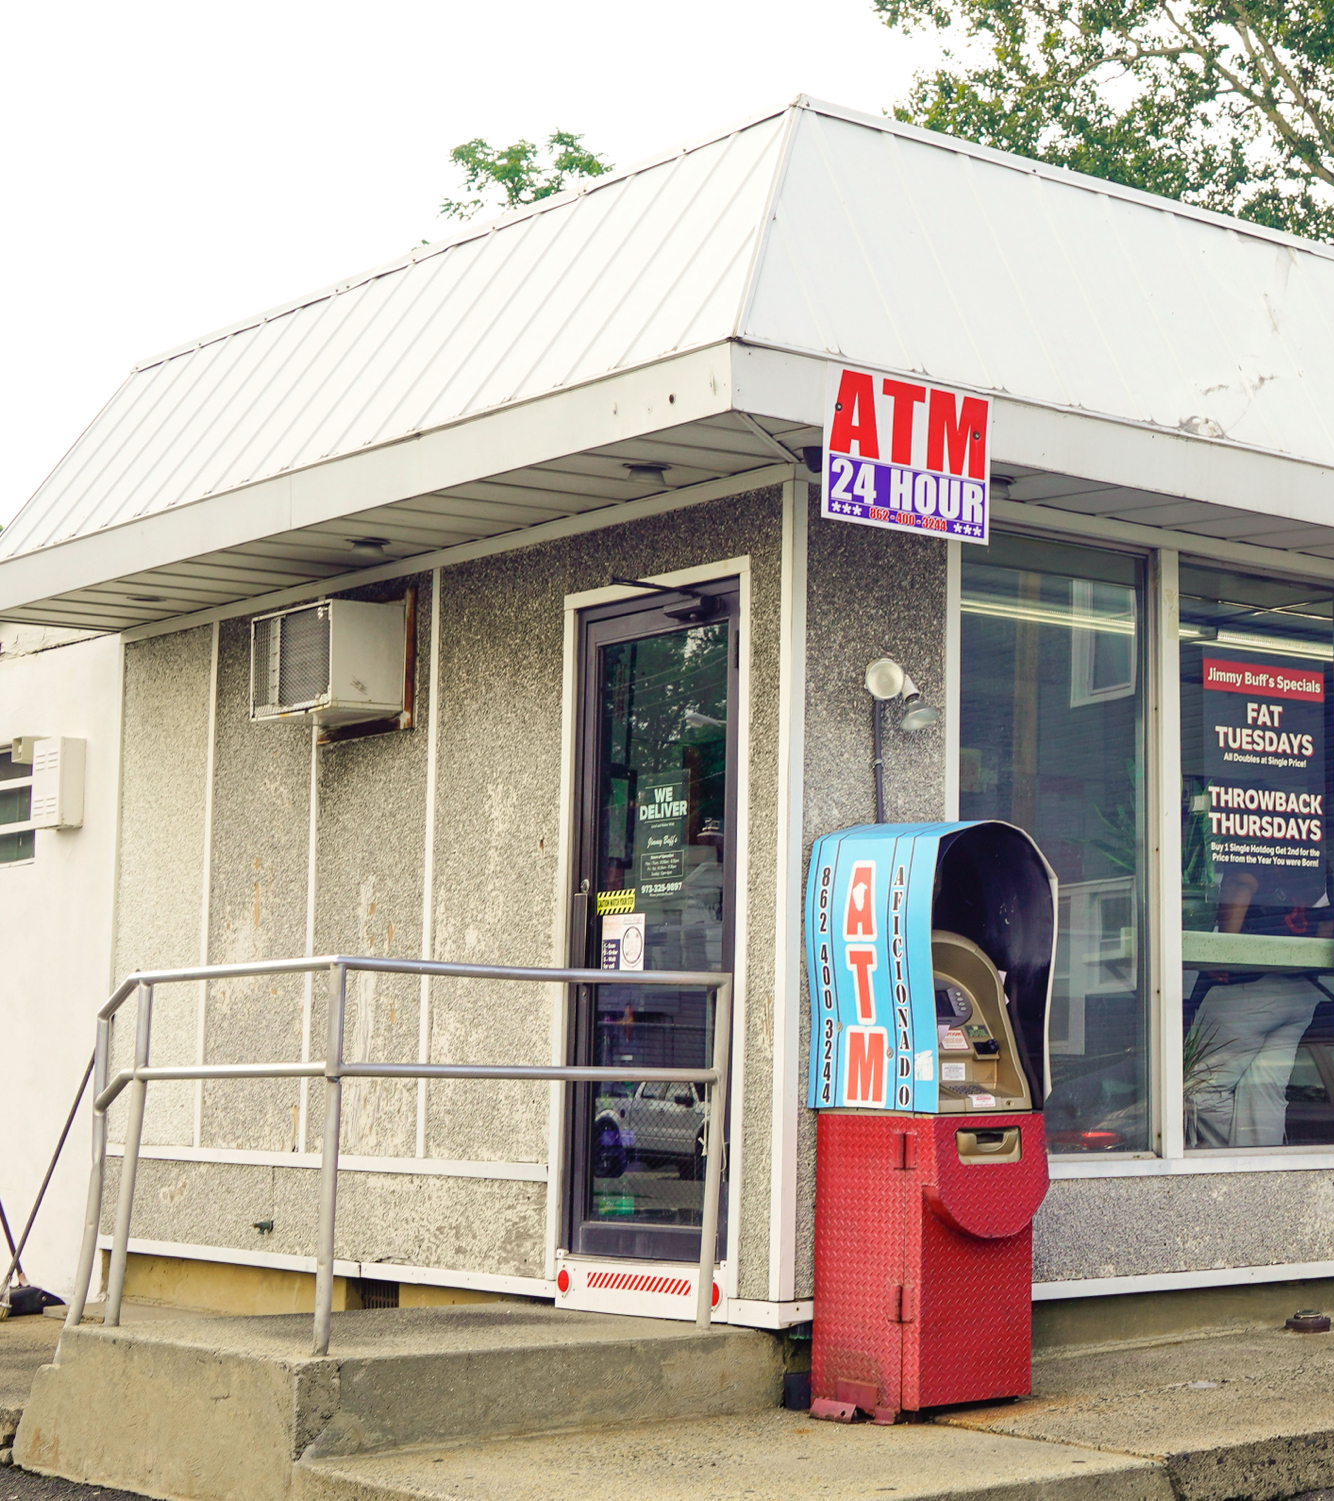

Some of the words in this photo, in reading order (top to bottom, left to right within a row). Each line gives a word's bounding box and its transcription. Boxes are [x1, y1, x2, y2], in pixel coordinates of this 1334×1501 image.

[829, 369, 989, 481] ATM
[830, 459, 877, 505] 24
[890, 467, 984, 523] HOUR
[1207, 667, 1242, 686] Jimmy
[1244, 672, 1275, 688] Buff's
[1277, 675, 1321, 693] Specials
[1247, 702, 1283, 728] FAT
[1215, 726, 1314, 758] TUESDAYS
[1224, 752, 1233, 761] All
[1234, 753, 1260, 764] Doubles
[1261, 757, 1268, 765] at
[1268, 756, 1288, 768] Single
[1288, 758, 1307, 768] Price!
[654, 786, 673, 803] WE
[1208, 786, 1323, 815] THROWBACK
[640, 800, 688, 820] DELIVER
[1208, 812, 1323, 842] THURSDAYS
[1211, 842, 1224, 852] Buy
[1224, 844, 1229, 852] 1
[1230, 843, 1250, 854] Single
[1250, 844, 1274, 856] Hotdog
[1275, 846, 1286, 856] Get
[1287, 846, 1299, 856] 2nd
[1299, 848, 1309, 856] for
[1310, 848, 1320, 857] the
[1212, 852, 1229, 862] Price
[1230, 853, 1246, 863] from
[1246, 854, 1256, 864] the
[1257, 856, 1272, 864] Year
[1272, 856, 1286, 866] You
[1286, 858, 1301, 866] were
[1302, 859, 1320, 868] Born!
[818, 866, 832, 933] 862
[820, 943, 832, 1010] 400
[844, 862, 886, 1106] ATM
[892, 865, 911, 1107] AFICIONADO
[822, 1017, 833, 1104] 3244
